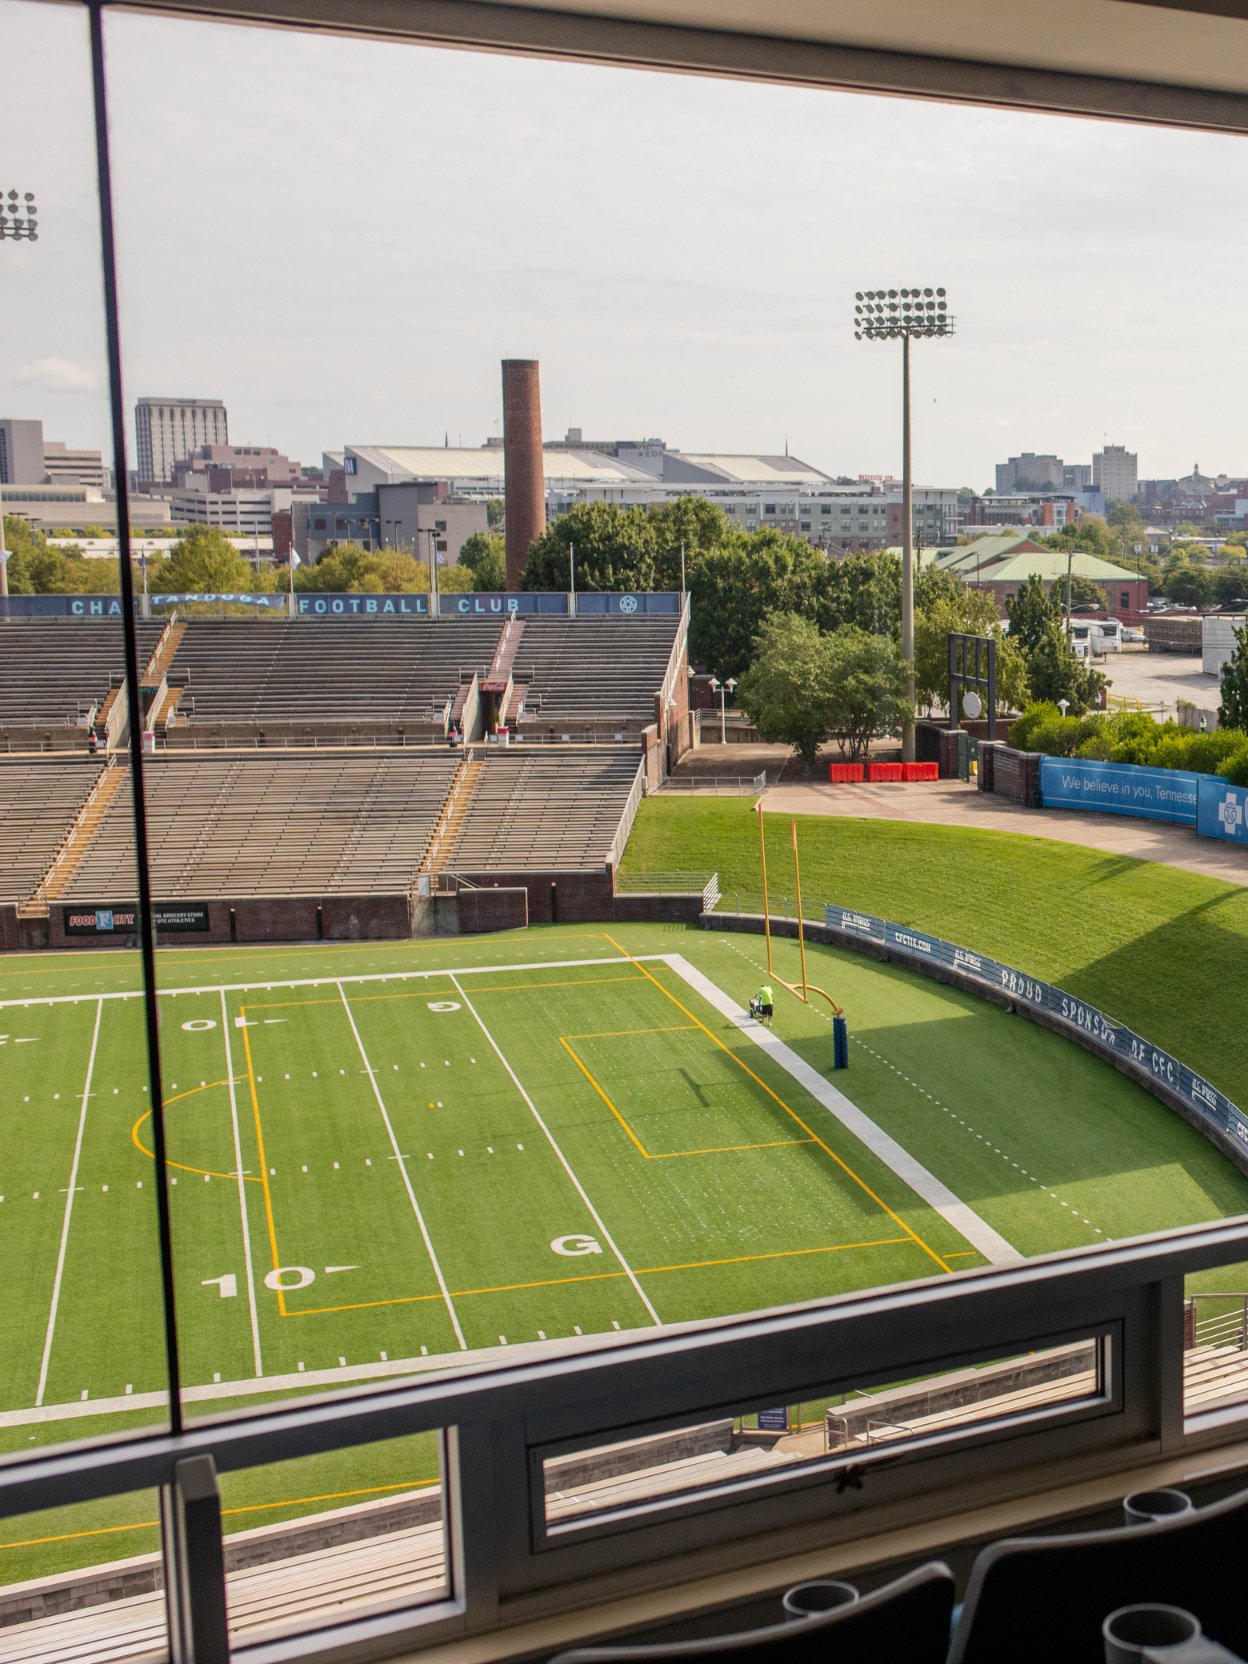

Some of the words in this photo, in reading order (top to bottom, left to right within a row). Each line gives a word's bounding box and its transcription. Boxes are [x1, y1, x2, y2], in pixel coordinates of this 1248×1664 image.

[299, 598, 428, 614] FOOTBALL
[458, 598, 519, 613] CLUB
[1062, 775, 1081, 789] We
[1083, 778, 1119, 794] believe
[1122, 782, 1130, 795] in
[1133, 785, 1153, 800] you,
[1155, 785, 1197, 805] Tennesse
[69, 915, 96, 926] FOOD
[112, 913, 135, 925] CITY
[895, 932, 932, 953] CFCTIX.COM
[1001, 970, 1042, 1003] PROUD
[1062, 997, 1116, 1046] SPONSOR
[1131, 1039, 1145, 1061] OF
[1152, 1052, 1174, 1083] CFC
[550, 1234, 603, 1257] G
[201, 1266, 316, 1298] 10
